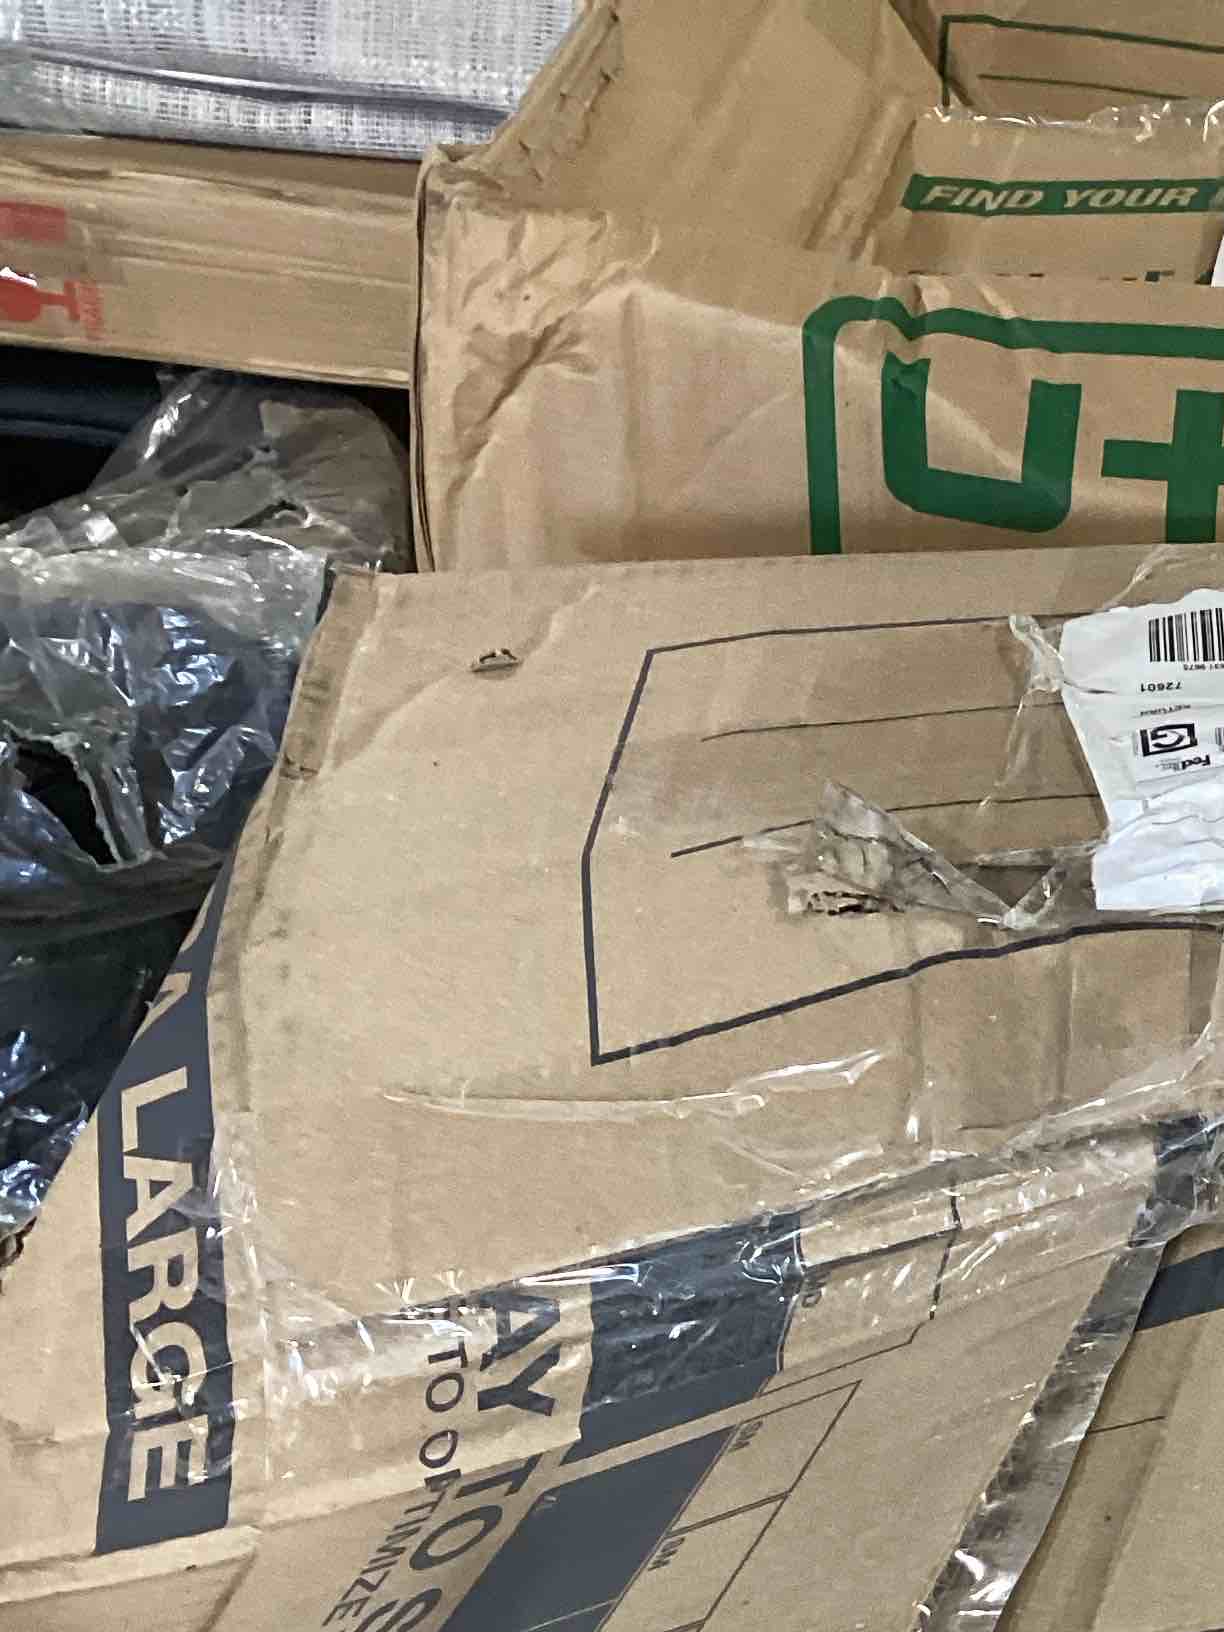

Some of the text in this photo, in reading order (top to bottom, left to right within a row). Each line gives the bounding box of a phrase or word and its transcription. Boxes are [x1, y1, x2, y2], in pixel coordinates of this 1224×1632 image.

[925, 184, 1044, 211] FIND
[1064, 185, 1200, 209] YOUR
[120, 1066, 209, 1501] LARGE
[409, 1452, 543, 1570] TO
